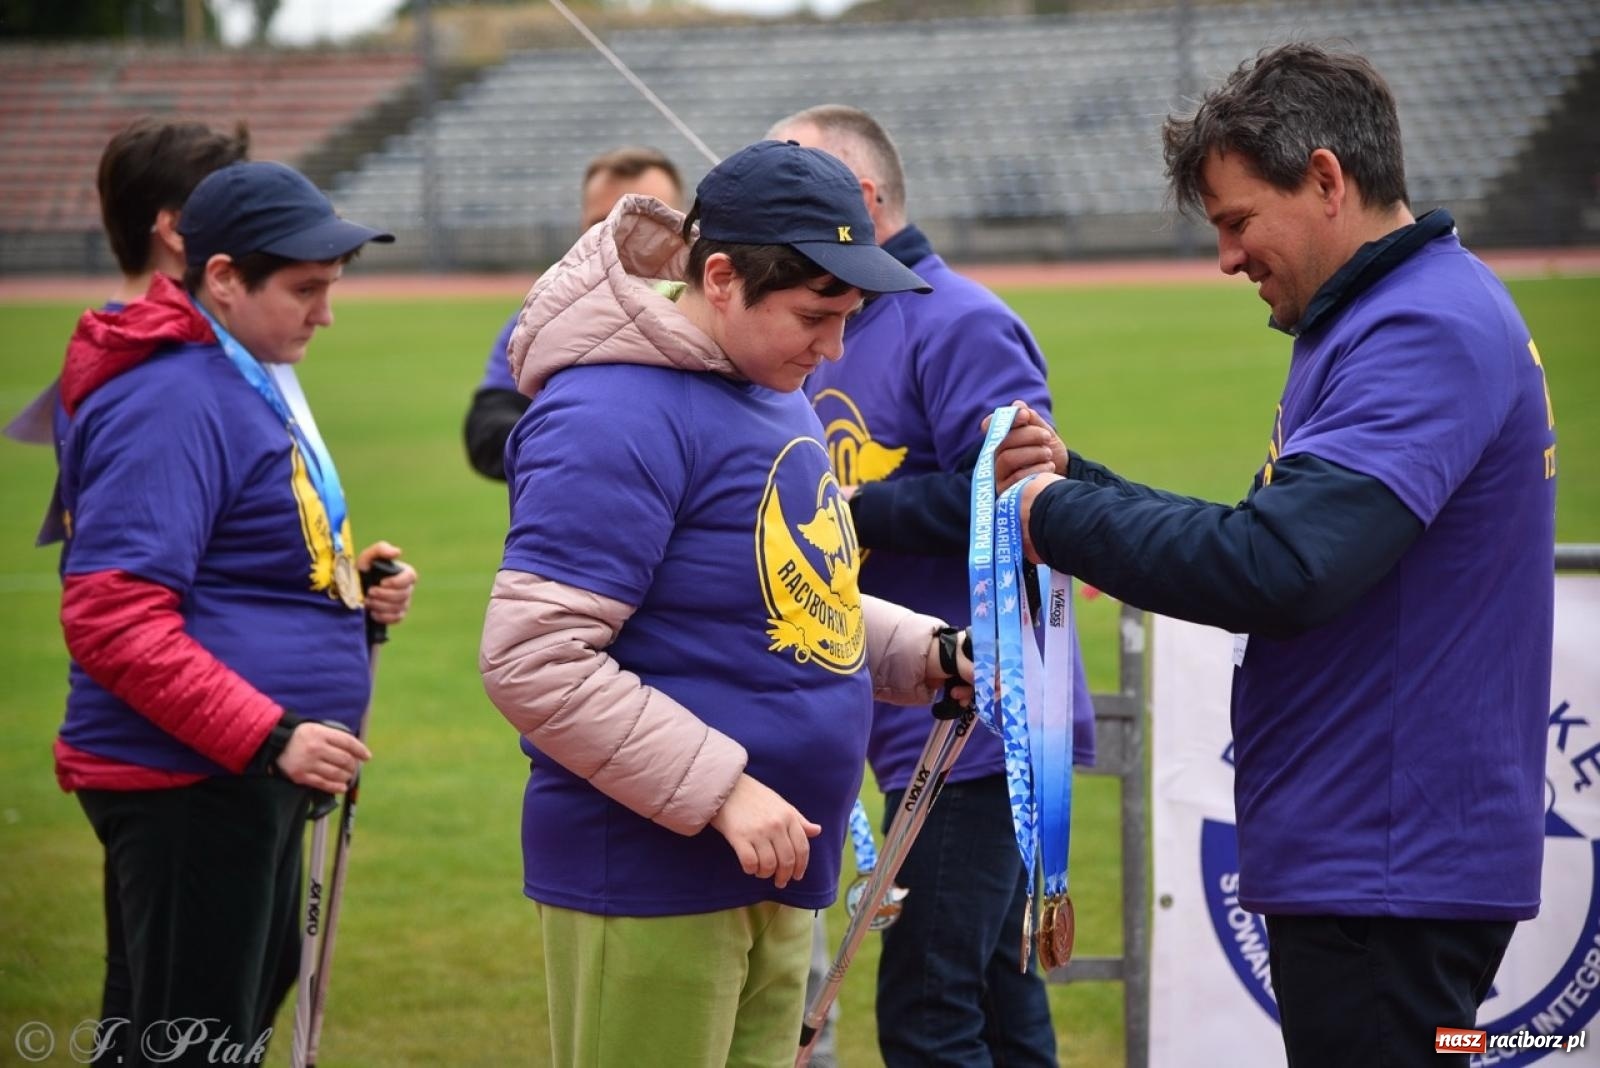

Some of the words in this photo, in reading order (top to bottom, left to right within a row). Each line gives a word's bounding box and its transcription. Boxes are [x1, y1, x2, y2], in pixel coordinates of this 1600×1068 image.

[837, 226, 853, 242] K
[975, 480, 993, 550] RACIBORSKI
[996, 517, 1012, 564] BARIER
[777, 559, 849, 638] RACIBORSKI
